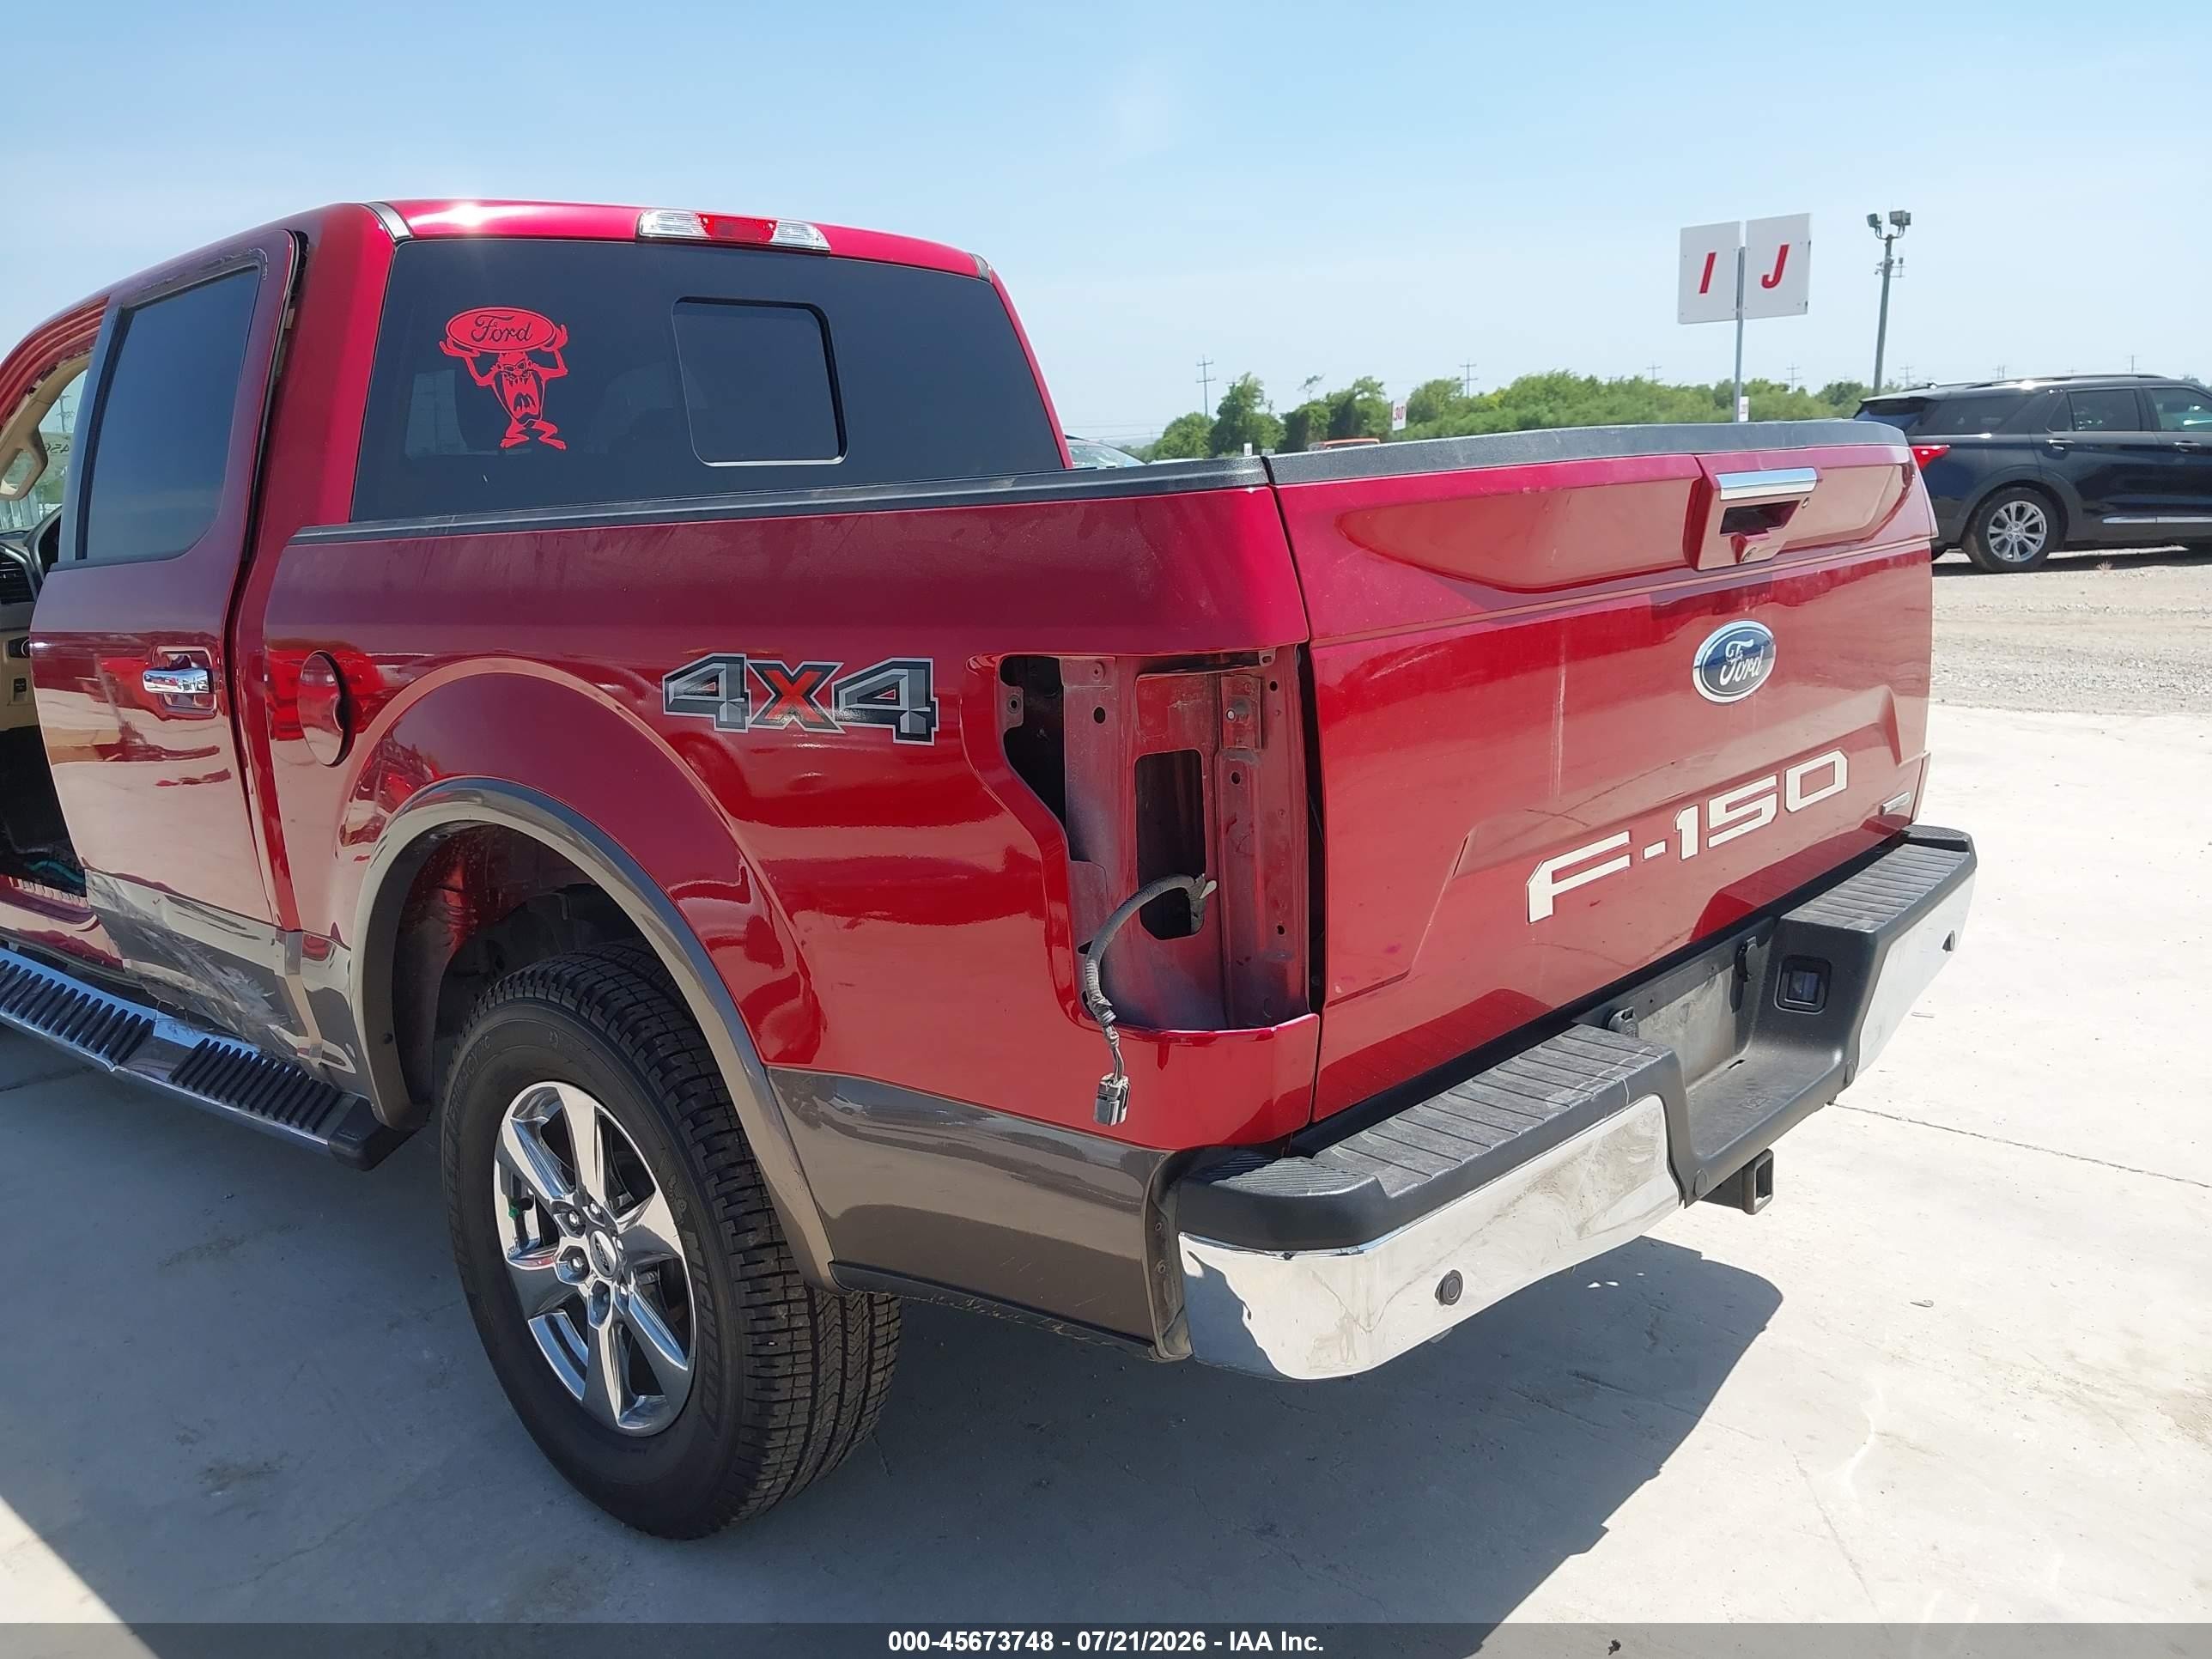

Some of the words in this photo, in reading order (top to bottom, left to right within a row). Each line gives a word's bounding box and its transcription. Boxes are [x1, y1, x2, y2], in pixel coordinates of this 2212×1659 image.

[1761, 244, 1790, 289] J
[471, 314, 533, 343] Ford
[1719, 638, 1765, 686] Ford
[1526, 749, 1849, 924] F-150
